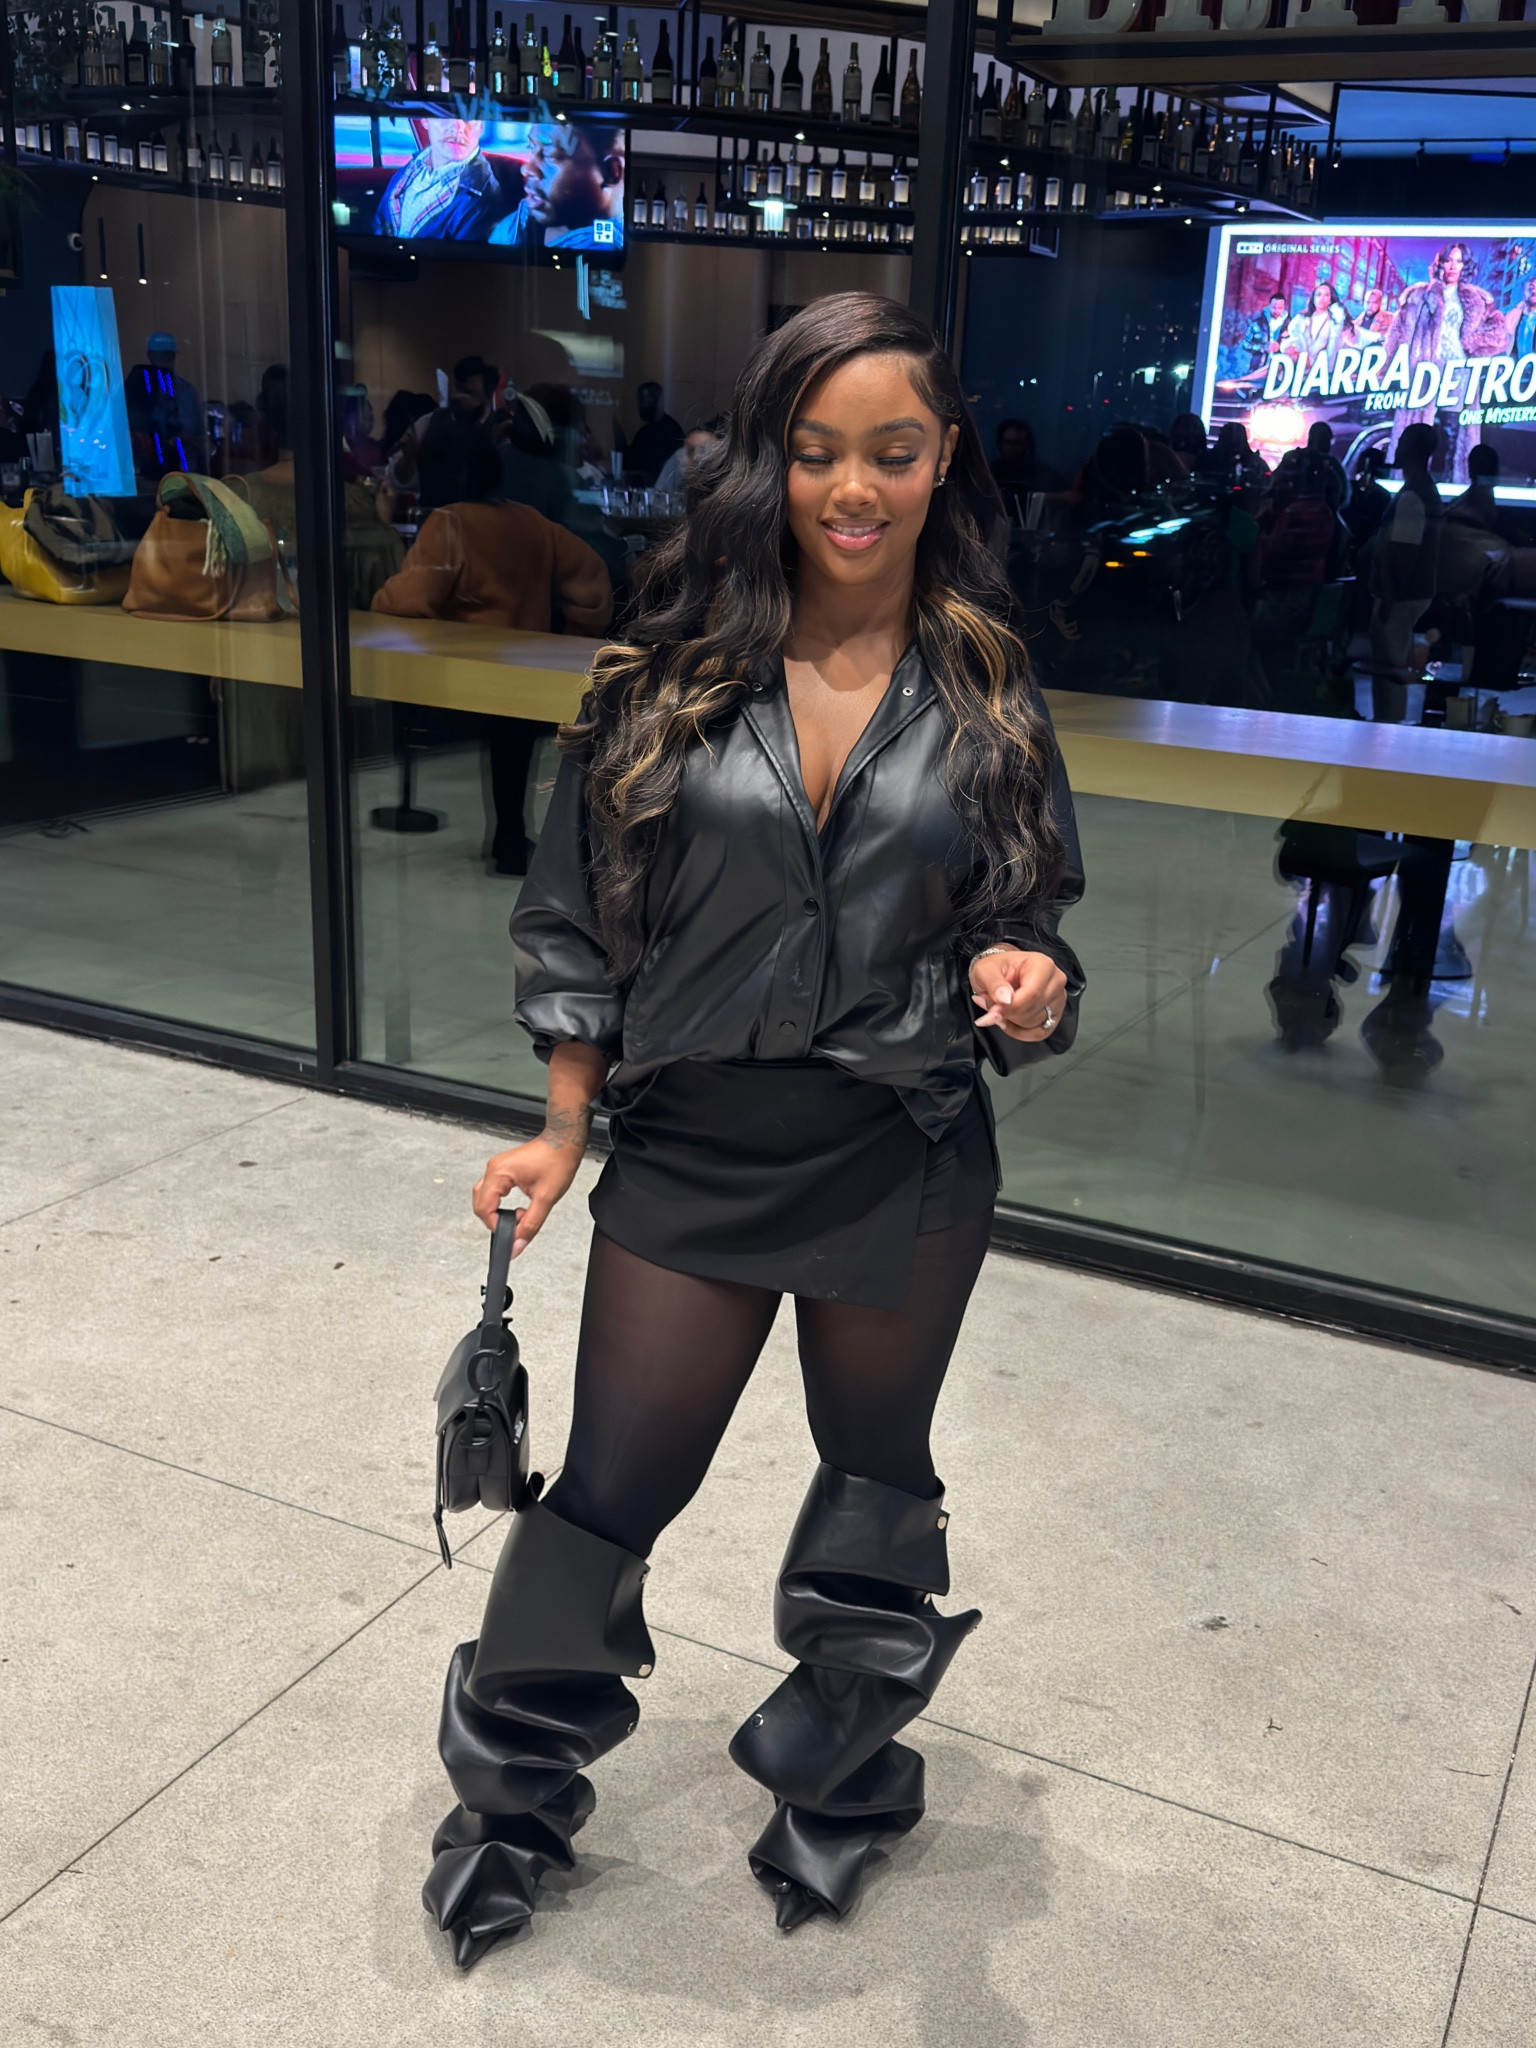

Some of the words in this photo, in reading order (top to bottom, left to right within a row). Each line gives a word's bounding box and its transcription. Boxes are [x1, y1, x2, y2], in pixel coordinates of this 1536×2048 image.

[1264, 242, 1308, 253] ORIGINAL
[1309, 243, 1340, 253] SERIES
[1262, 343, 1410, 400] DIARRA
[1364, 391, 1408, 411] FROM
[1458, 409, 1485, 426] ONE
